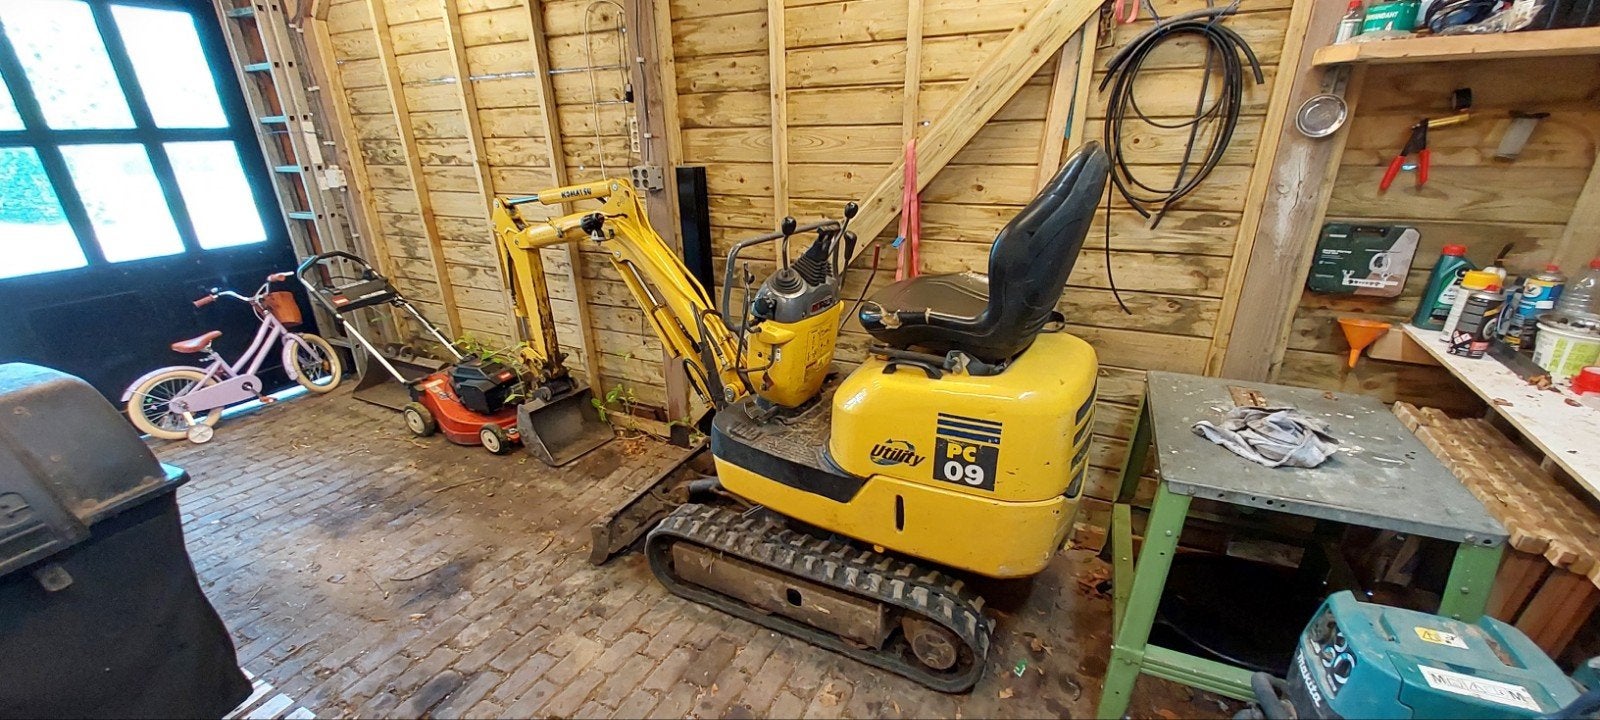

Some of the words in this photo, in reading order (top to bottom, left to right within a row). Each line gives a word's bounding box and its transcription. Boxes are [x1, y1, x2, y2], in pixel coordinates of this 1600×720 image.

[561, 187, 592, 198] KOMATSU
[870, 444, 926, 467] Utility
[947, 442, 977, 463] PC
[944, 461, 984, 485] 09
